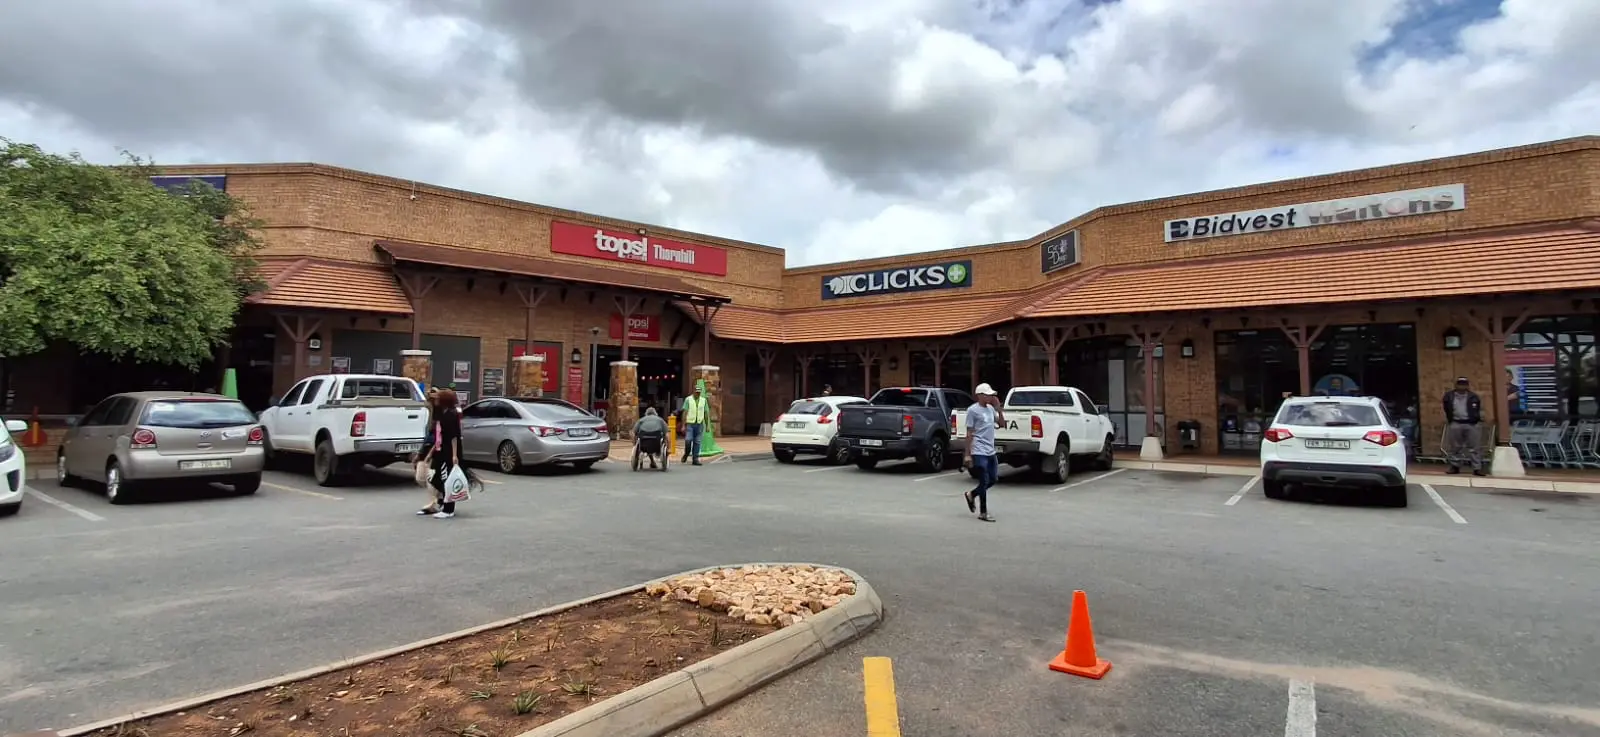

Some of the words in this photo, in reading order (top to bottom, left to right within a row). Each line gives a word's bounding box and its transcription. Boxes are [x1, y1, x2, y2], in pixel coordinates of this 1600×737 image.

[1192, 208, 1297, 237] Bidvest
[594, 229, 648, 260] tops!
[652, 244, 695, 265] Thornhill
[850, 265, 946, 293] CLICKS
[628, 316, 649, 329] ops!
